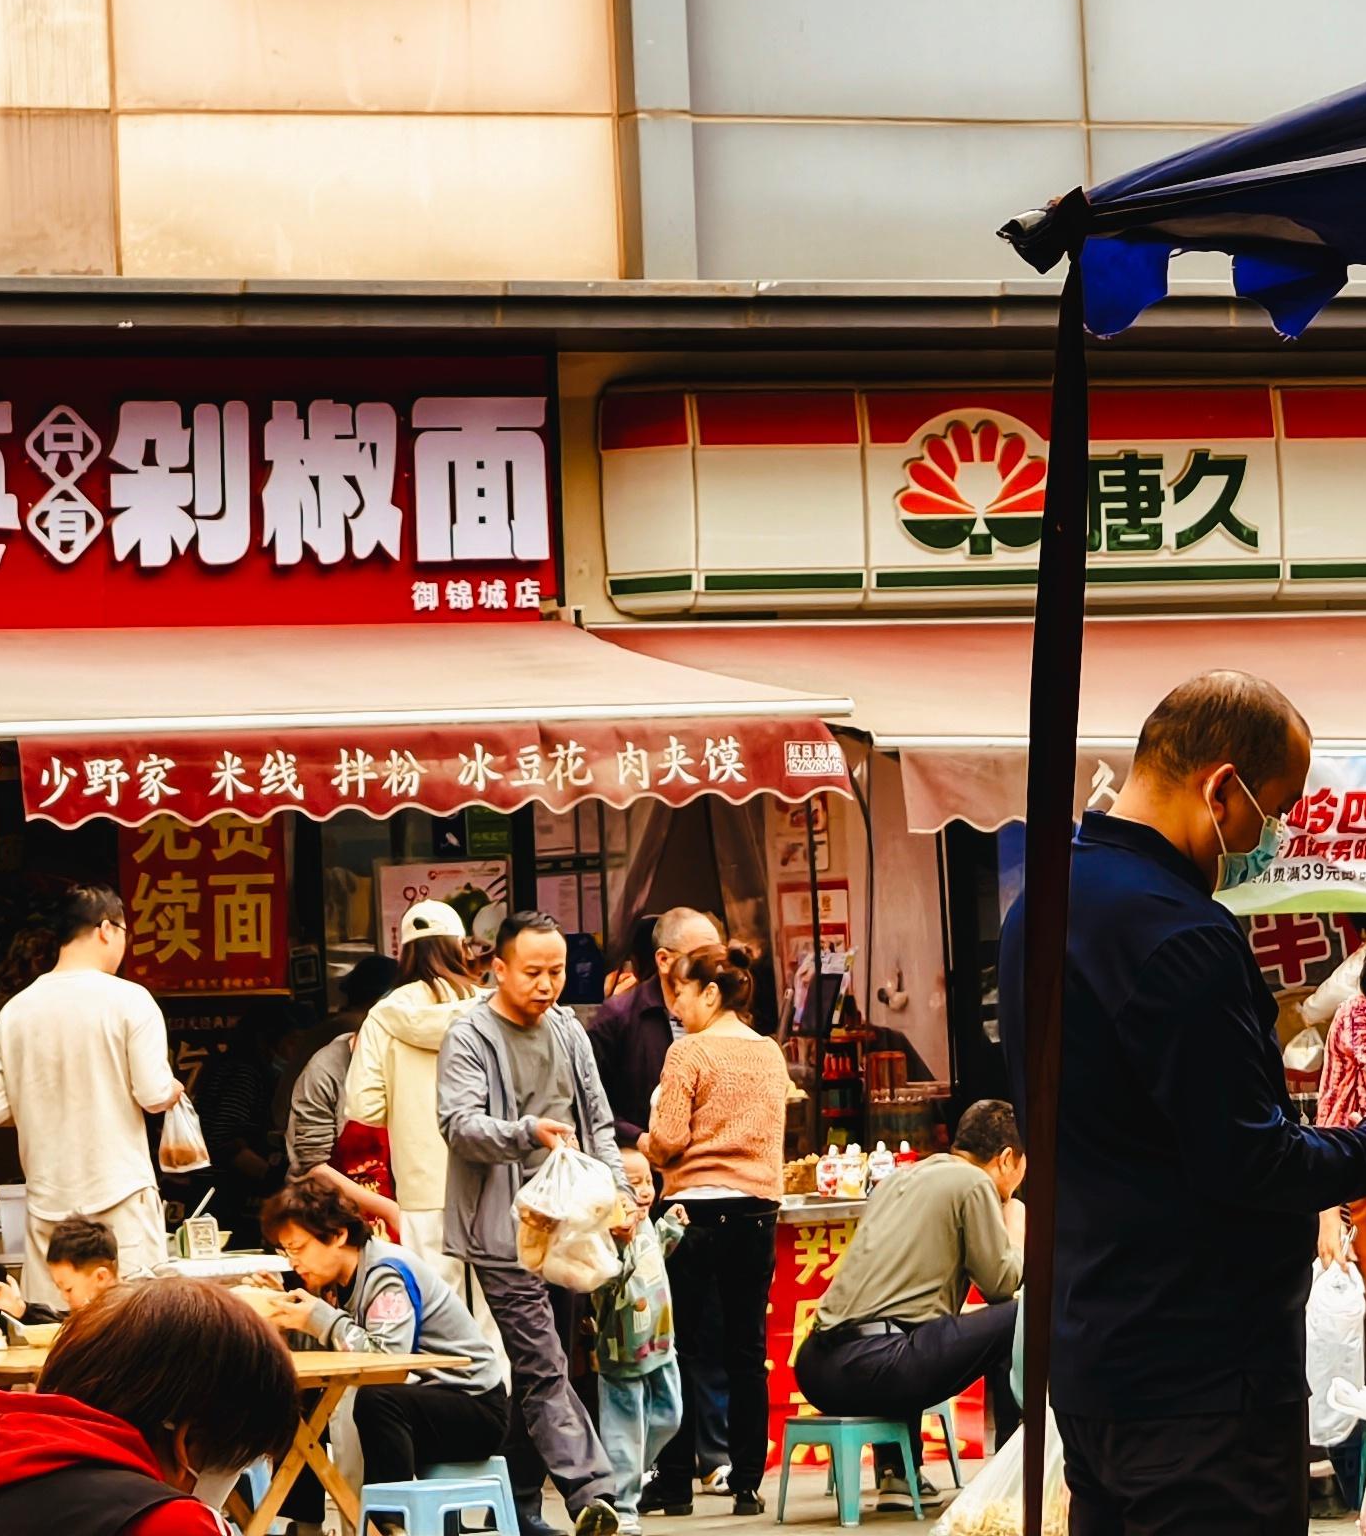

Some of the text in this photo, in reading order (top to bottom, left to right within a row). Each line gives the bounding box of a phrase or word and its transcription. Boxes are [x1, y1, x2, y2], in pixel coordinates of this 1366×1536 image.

[110, 396, 551, 568] 剁椒面
[1087, 448, 1259, 554] 唐久
[411, 579, 542, 611] 御锦城店
[37, 734, 747, 809] 少野家 米线 拌粉 冰豆花 肉夹馍
[131, 872, 275, 964] 续面
